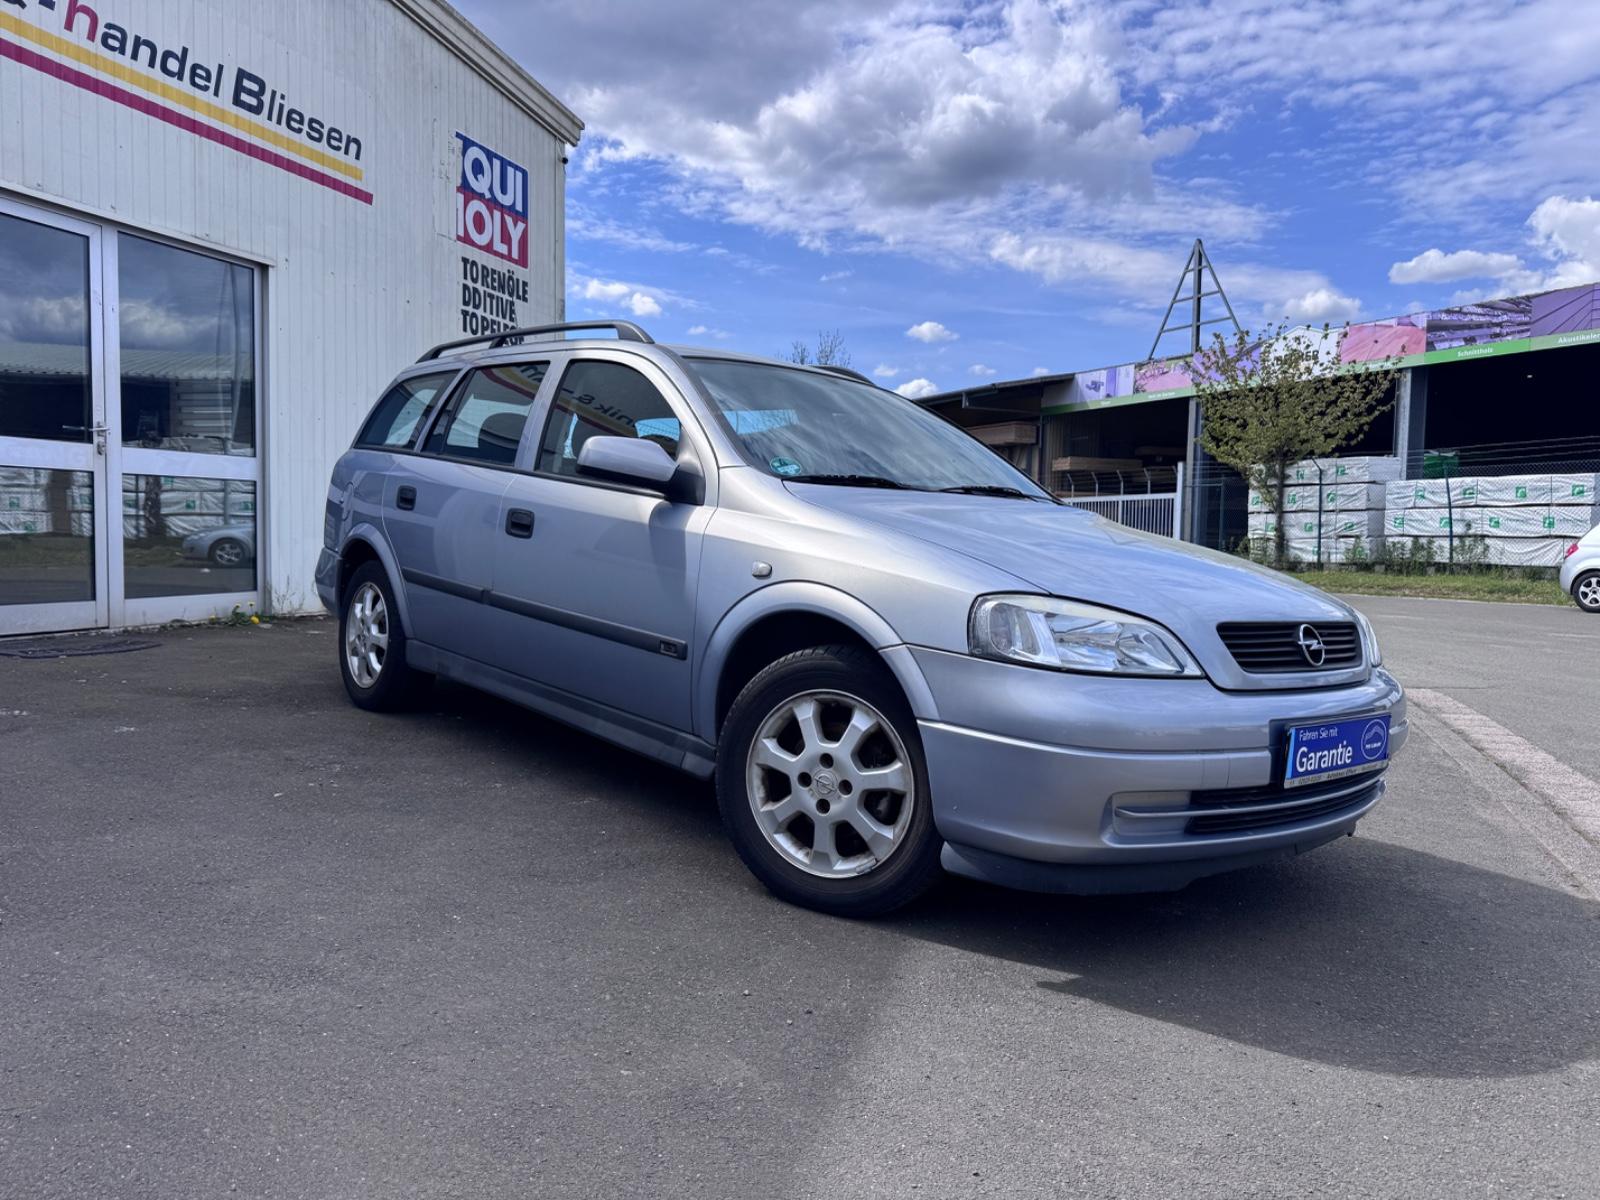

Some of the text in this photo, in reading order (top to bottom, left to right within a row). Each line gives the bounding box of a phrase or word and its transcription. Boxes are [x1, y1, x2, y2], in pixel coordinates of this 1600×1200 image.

[232, 66, 362, 161] Bliesen
[463, 146, 523, 212] QUI
[462, 283, 515, 322] DDITIVE
[1299, 729, 1319, 741] Fahren
[1296, 740, 1353, 773] Garantie
